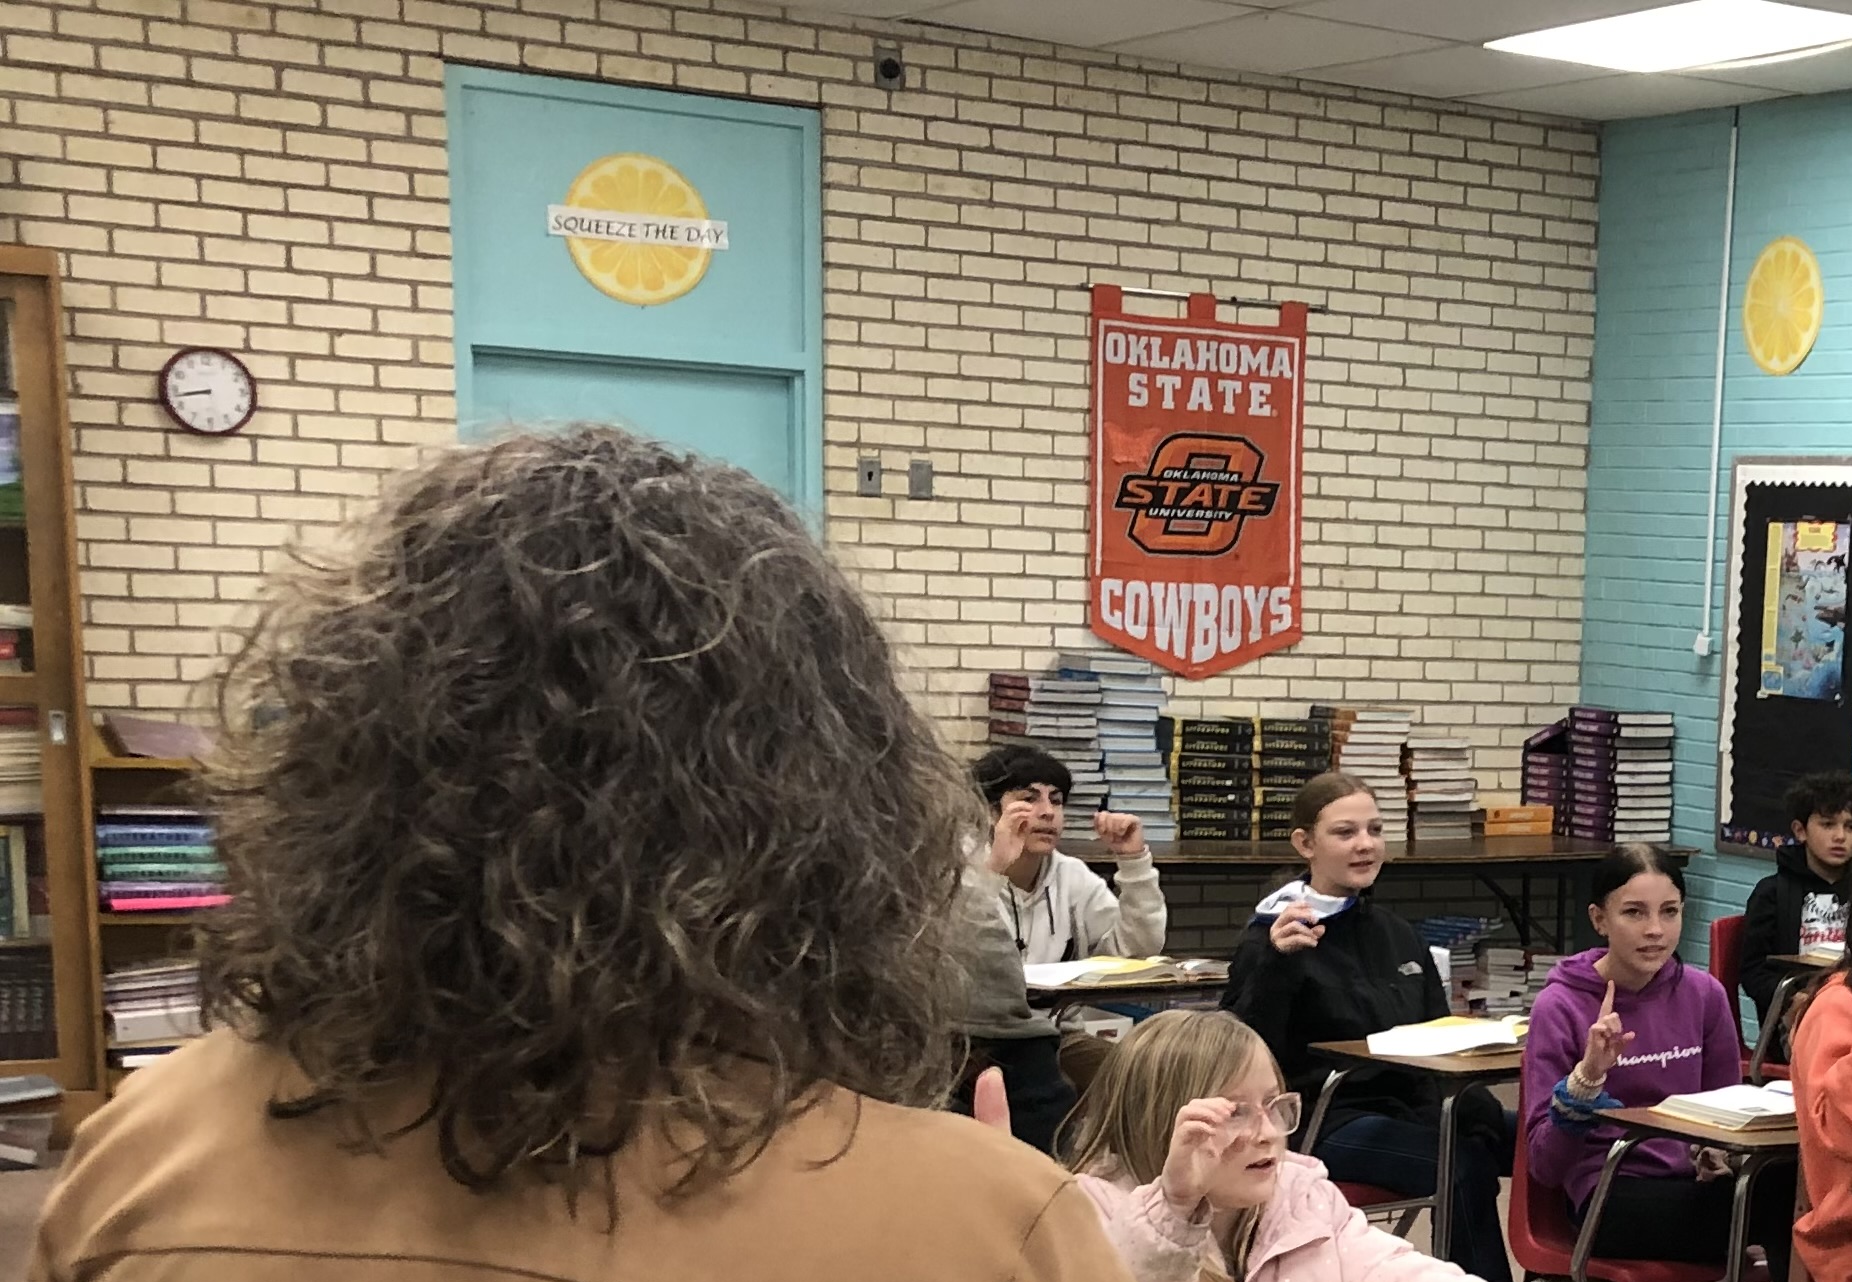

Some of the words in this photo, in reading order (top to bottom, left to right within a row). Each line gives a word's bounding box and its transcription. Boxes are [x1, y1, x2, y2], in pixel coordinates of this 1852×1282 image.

[552, 215, 637, 238] SQUEEZE
[642, 223, 680, 240] THE
[685, 227, 724, 244] DAY
[1105, 332, 1292, 379] OKLAHOMA
[1128, 373, 1272, 417] STATE
[1163, 470, 1239, 482] OKLAHOMA
[1122, 480, 1272, 510] STATE
[1148, 508, 1233, 520] UNIVERSITY
[1101, 578, 1292, 664] COWBOYS
[1616, 1045, 1702, 1068] hampion
